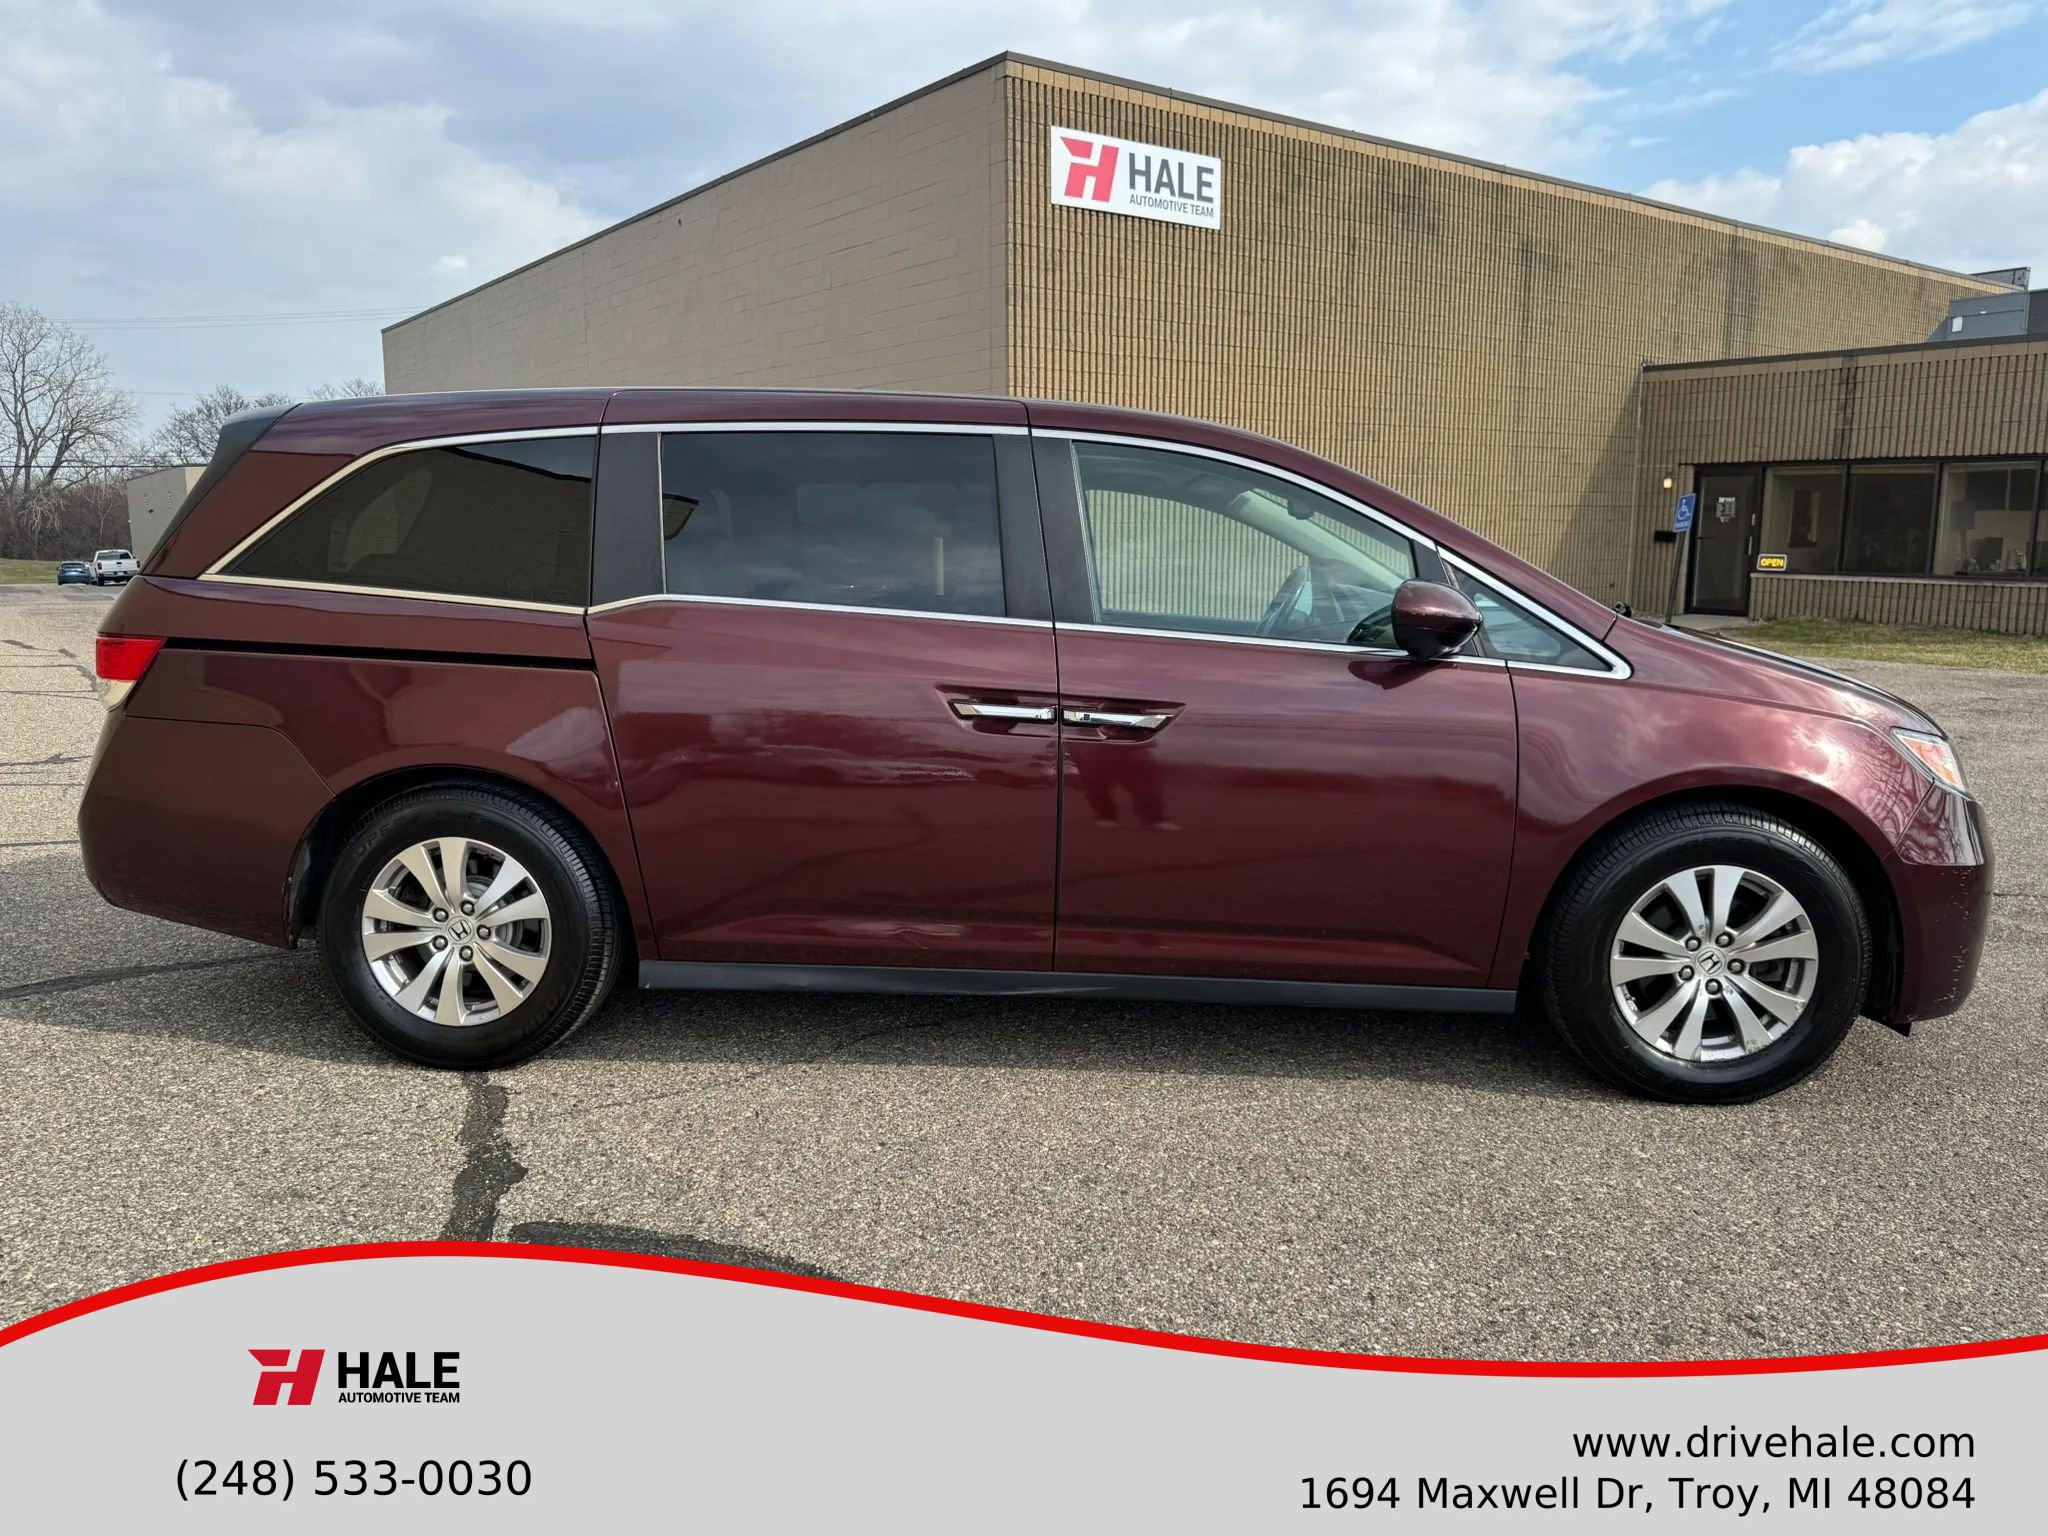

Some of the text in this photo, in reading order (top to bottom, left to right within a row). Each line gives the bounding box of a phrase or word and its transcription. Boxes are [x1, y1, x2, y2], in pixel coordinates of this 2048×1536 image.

[1129, 151, 1214, 204] HALE
[1129, 193, 1214, 218] AUTOMOTIVE TEAM
[1760, 558, 1784, 568] OPEN
